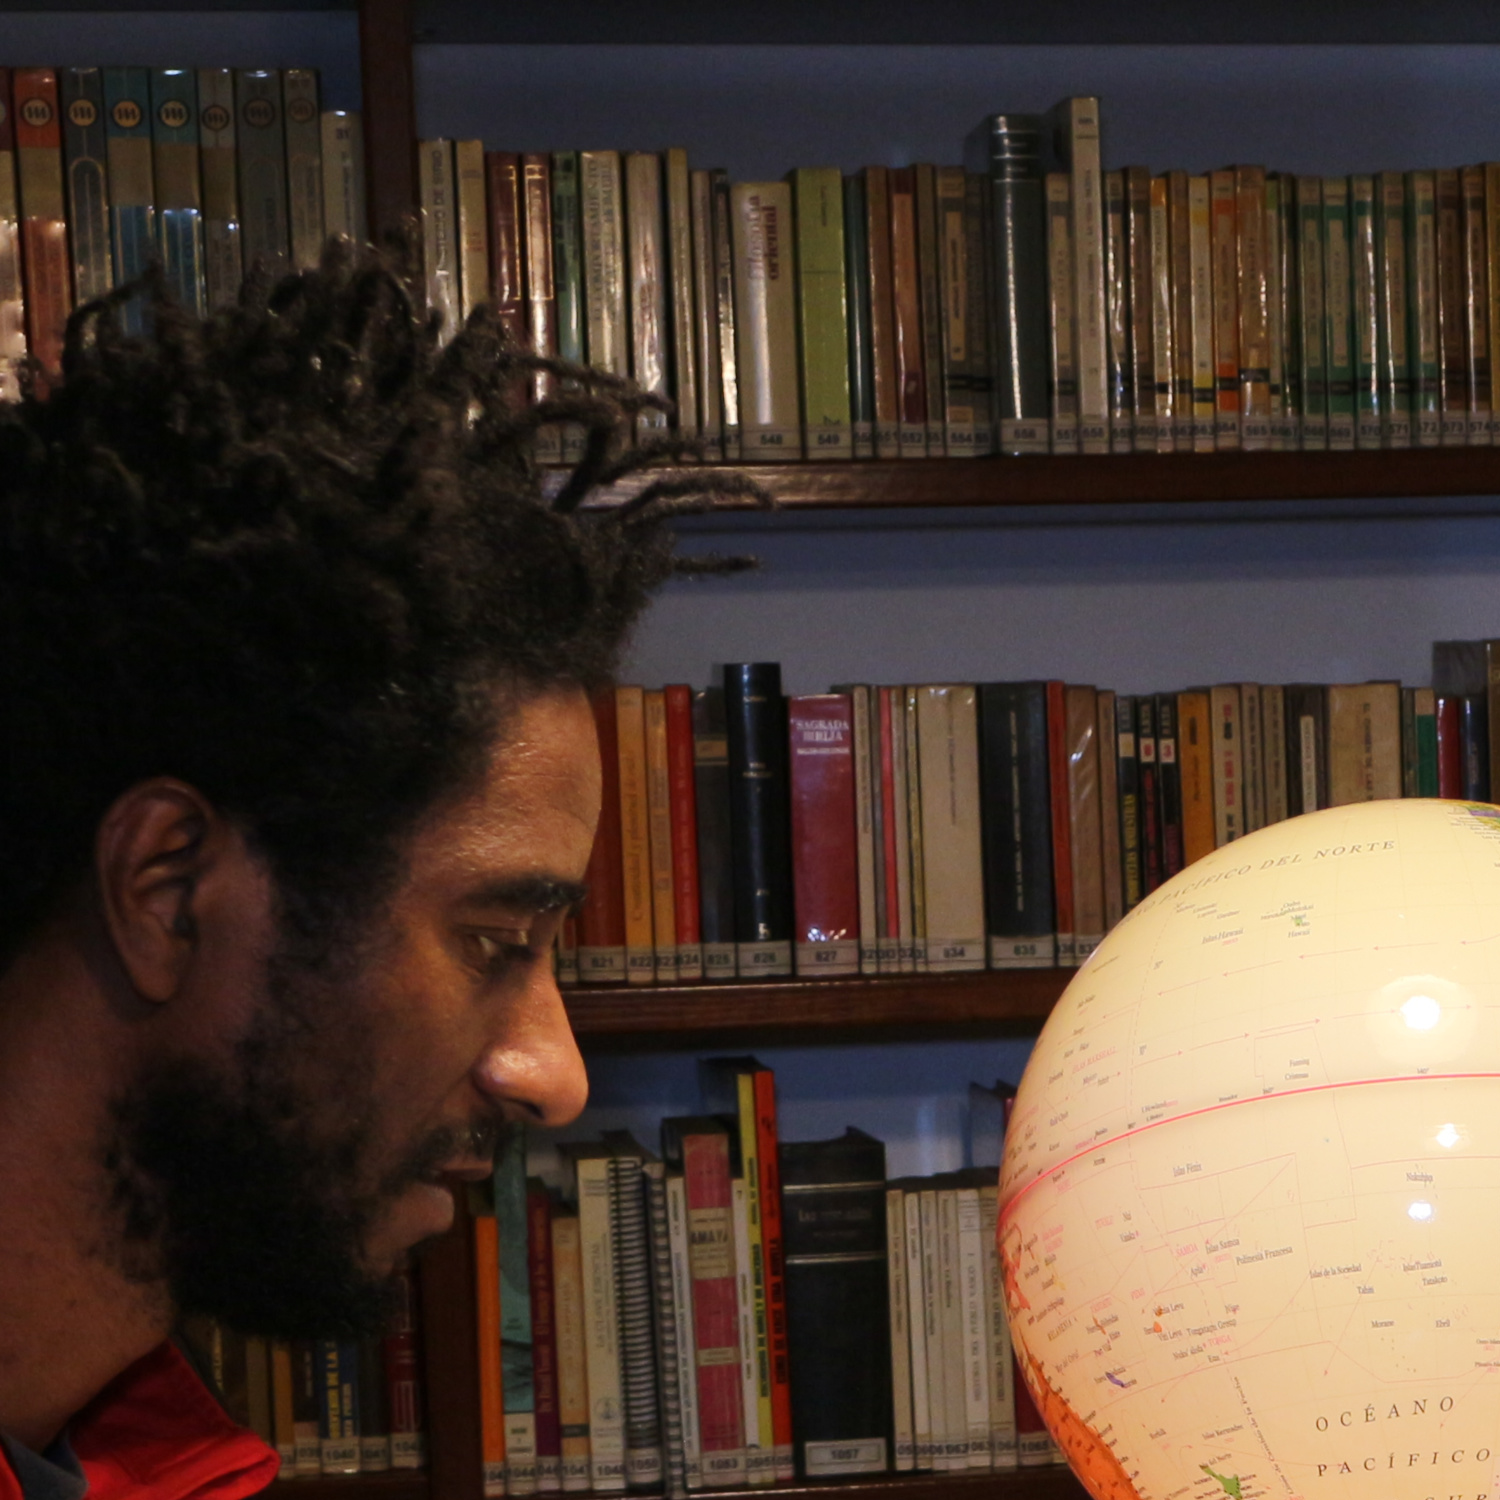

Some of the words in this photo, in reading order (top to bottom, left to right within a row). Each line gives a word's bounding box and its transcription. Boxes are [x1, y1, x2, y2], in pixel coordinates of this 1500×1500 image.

[1442, 422, 1463, 432] 573
[760, 433, 783, 444] 548
[818, 434, 840, 444] 549
[1258, 853, 1303, 871] DEL
[1312, 839, 1396, 860] NORTE
[815, 952, 837, 962] 827
[943, 947, 965, 957] 834
[1315, 1395, 1455, 1432] OCÉANO
[830, 1449, 859, 1459] 1057
[1316, 1447, 1491, 1477] PACÍFICO
